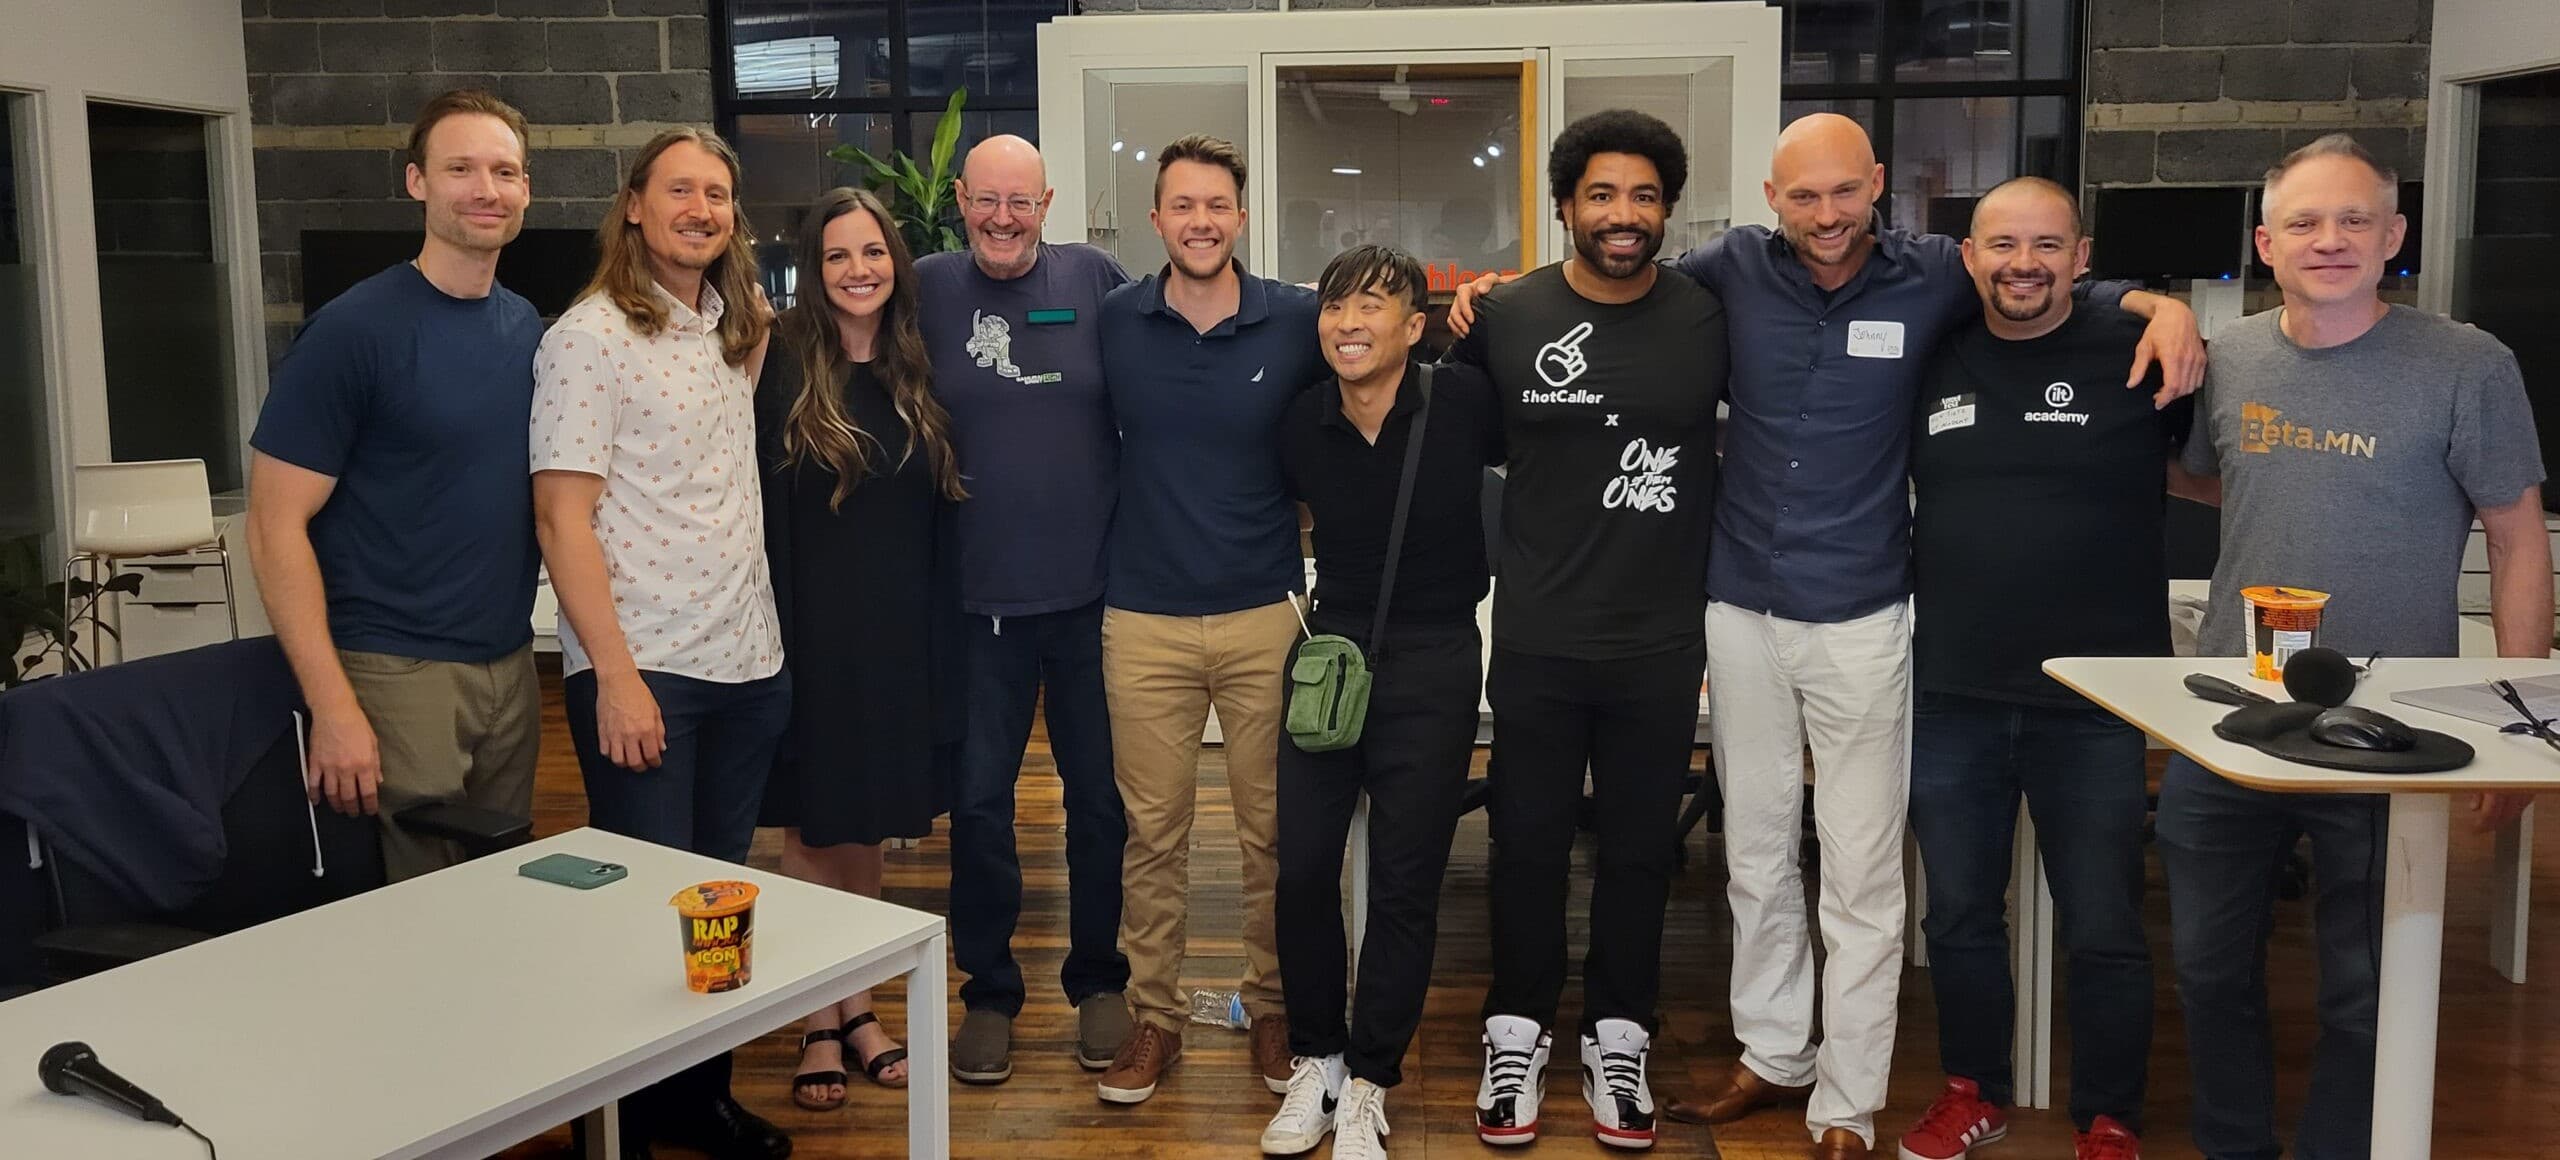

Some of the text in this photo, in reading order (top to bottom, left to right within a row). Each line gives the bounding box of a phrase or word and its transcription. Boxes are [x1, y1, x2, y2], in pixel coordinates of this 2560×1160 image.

[1522, 389, 1604, 404] ShotCaller
[2024, 410, 2090, 426] academy
[1620, 437, 1681, 473] ONE
[1602, 475, 1677, 513] ONES
[693, 915, 739, 941] RAP
[697, 948, 736, 964] ICON
